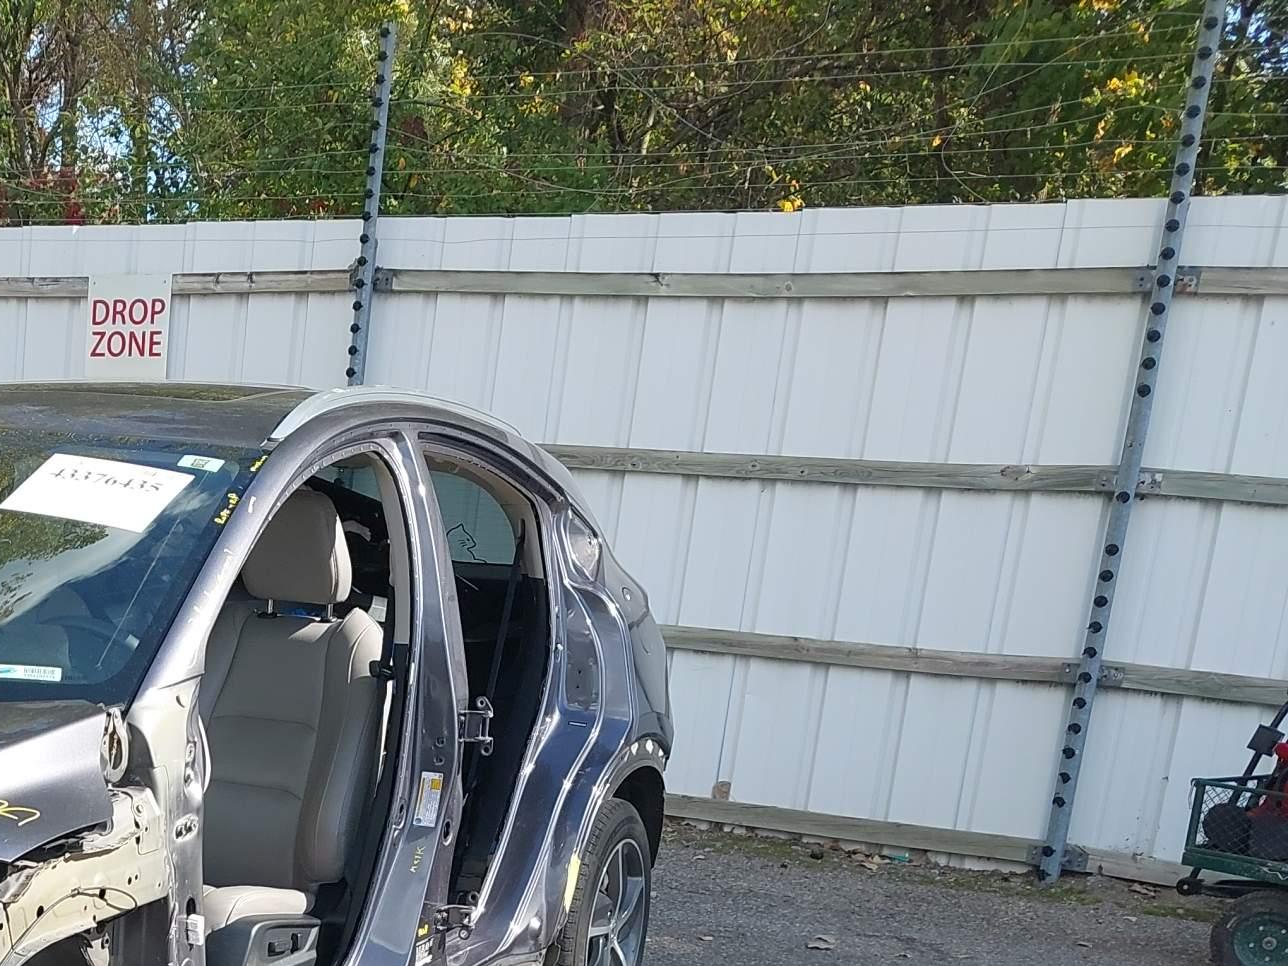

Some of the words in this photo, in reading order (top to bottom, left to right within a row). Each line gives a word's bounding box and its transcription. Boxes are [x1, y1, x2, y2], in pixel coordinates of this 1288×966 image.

[91, 298, 166, 326] DROP
[89, 330, 163, 358] ZONE
[50, 467, 164, 492] 43376435
